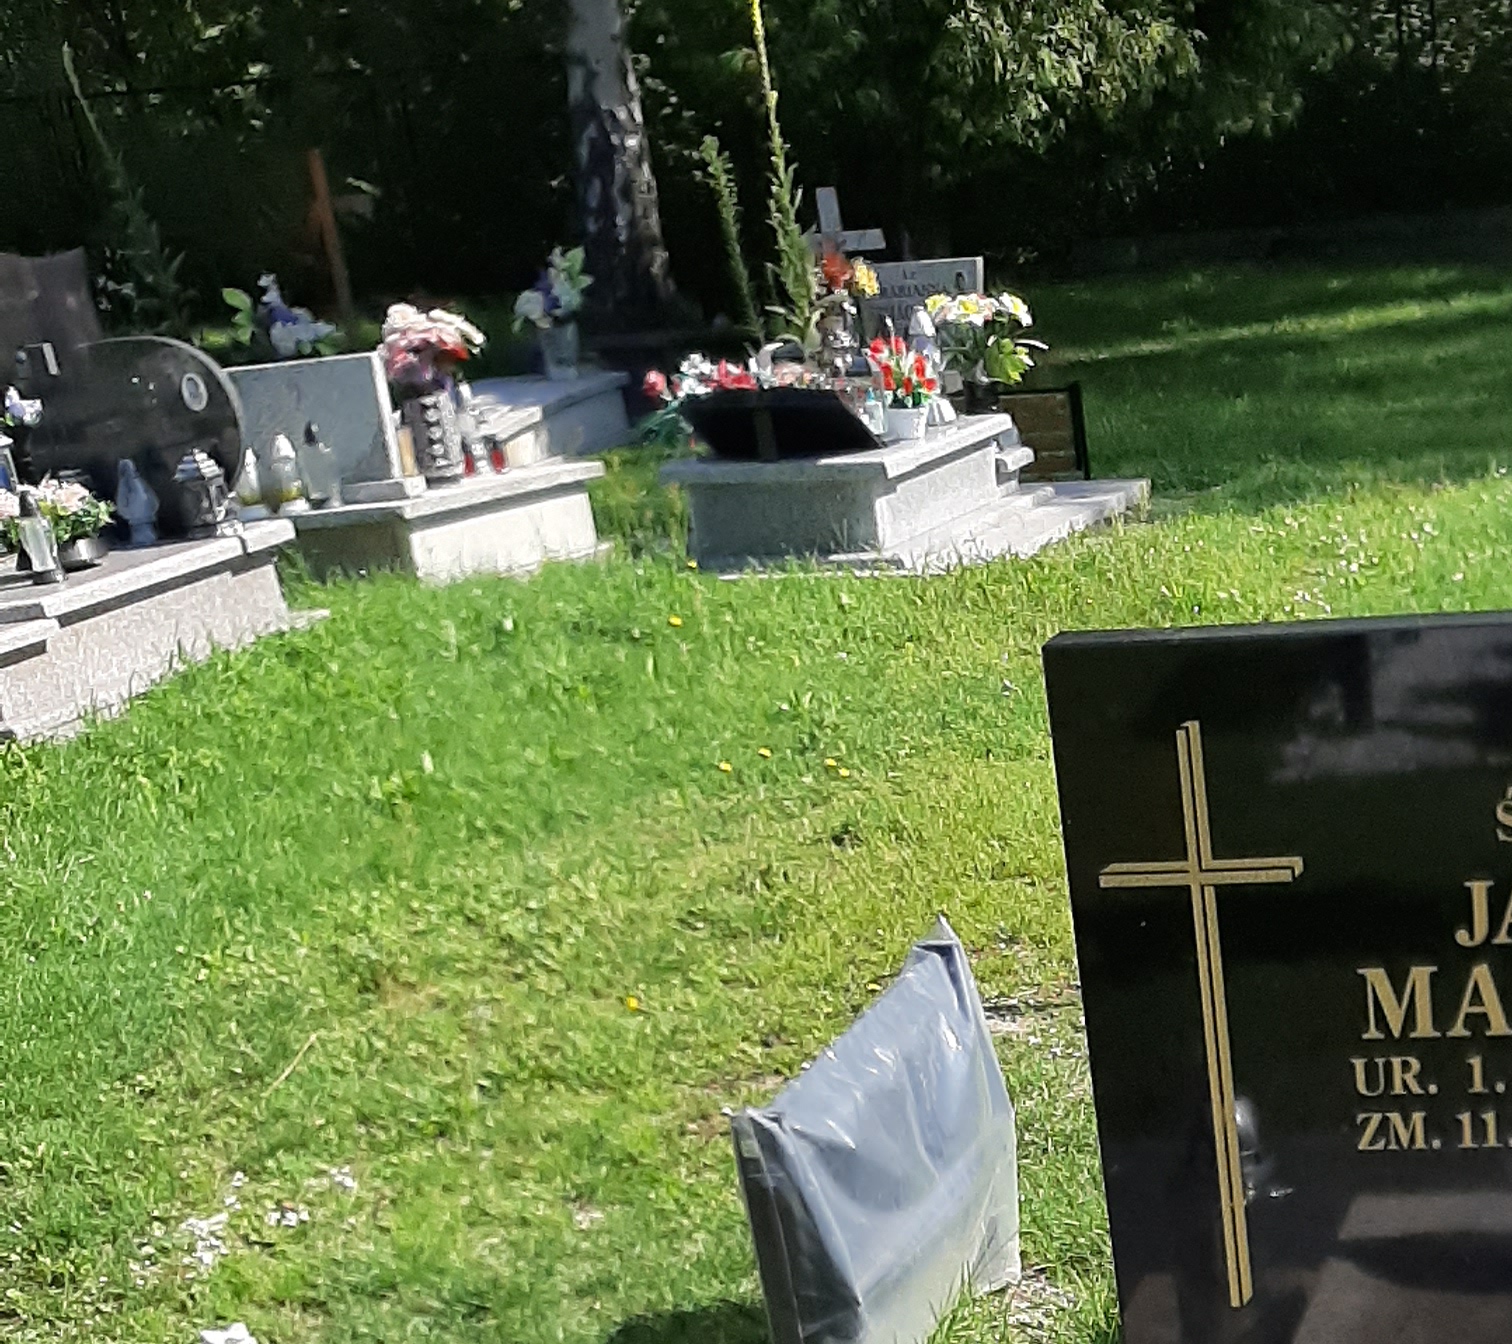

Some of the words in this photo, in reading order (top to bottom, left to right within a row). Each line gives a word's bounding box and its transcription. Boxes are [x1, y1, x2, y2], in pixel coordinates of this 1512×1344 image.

[1349, 1054, 1440, 1097] UR.
[1465, 1054, 1507, 1095] 1.
[1355, 1110, 1442, 1152] ZM.
